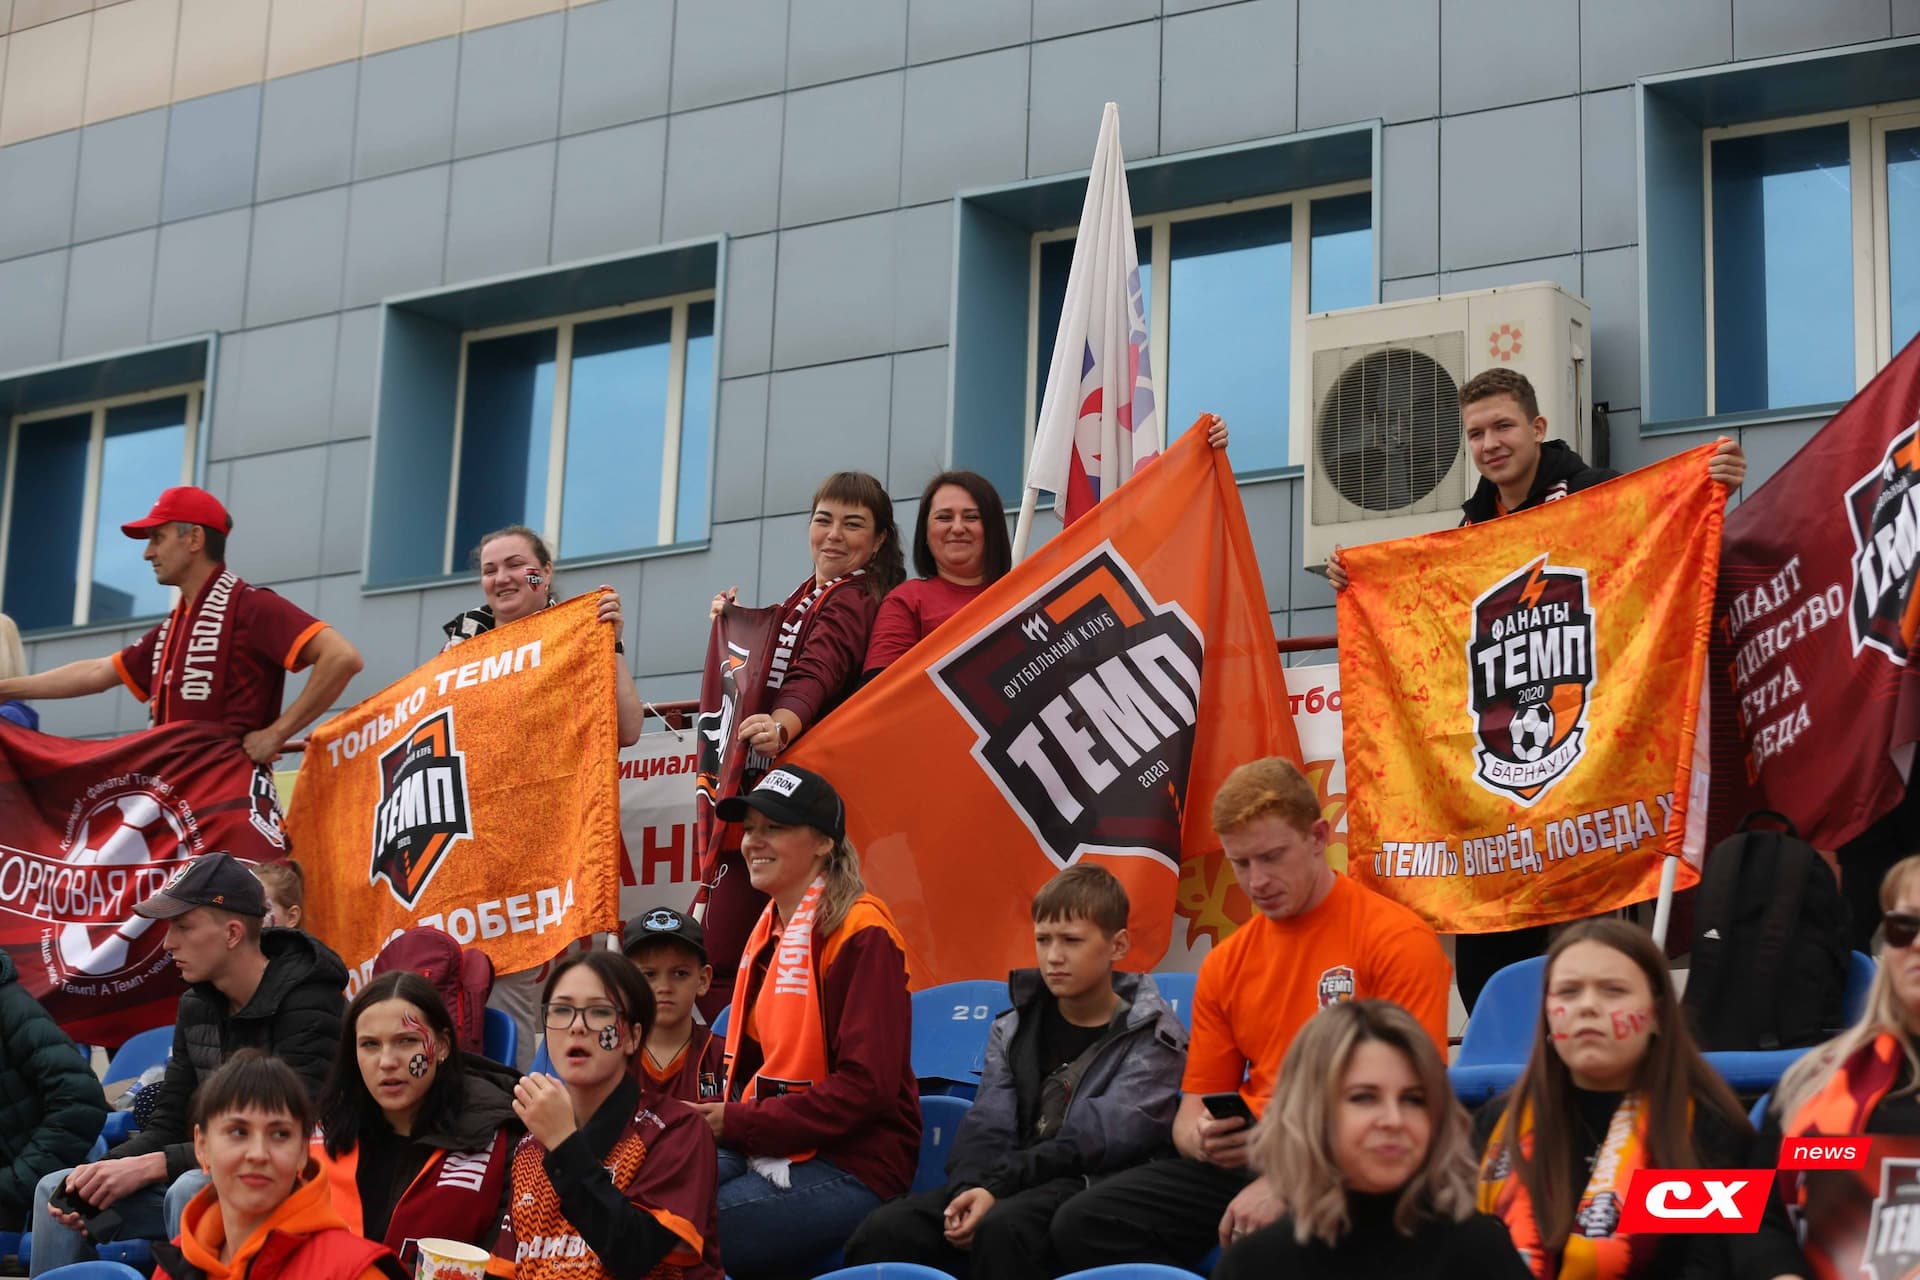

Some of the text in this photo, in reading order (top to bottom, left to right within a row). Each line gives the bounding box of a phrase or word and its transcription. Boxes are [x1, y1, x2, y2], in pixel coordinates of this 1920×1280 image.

[1003, 612, 1115, 699] ФУТБОЛЬНЫЙ КЛУБ
[1491, 601, 1570, 641] ФАНАТЫ
[1477, 625, 1586, 698] ТЕМП
[1518, 684, 1545, 704] 2020
[327, 686, 426, 768] ТОЛЬКО
[433, 640, 543, 697] ТЕМП
[1006, 633, 1201, 825] ТЕМП
[1137, 760, 1170, 789] 2020
[1491, 744, 1572, 783] БАРНАУЛ
[377, 766, 457, 857] ТЕМП
[1373, 841, 1459, 878] «ТЕМП»
[1462, 824, 1543, 877] ВПЕРЁД,
[1545, 800, 1657, 859] ПОБЕДА
[0, 852, 127, 921] ОРДОВАЯ
[951, 1005, 988, 1020] 20
[1321, 979, 1352, 994] ТЕМП
